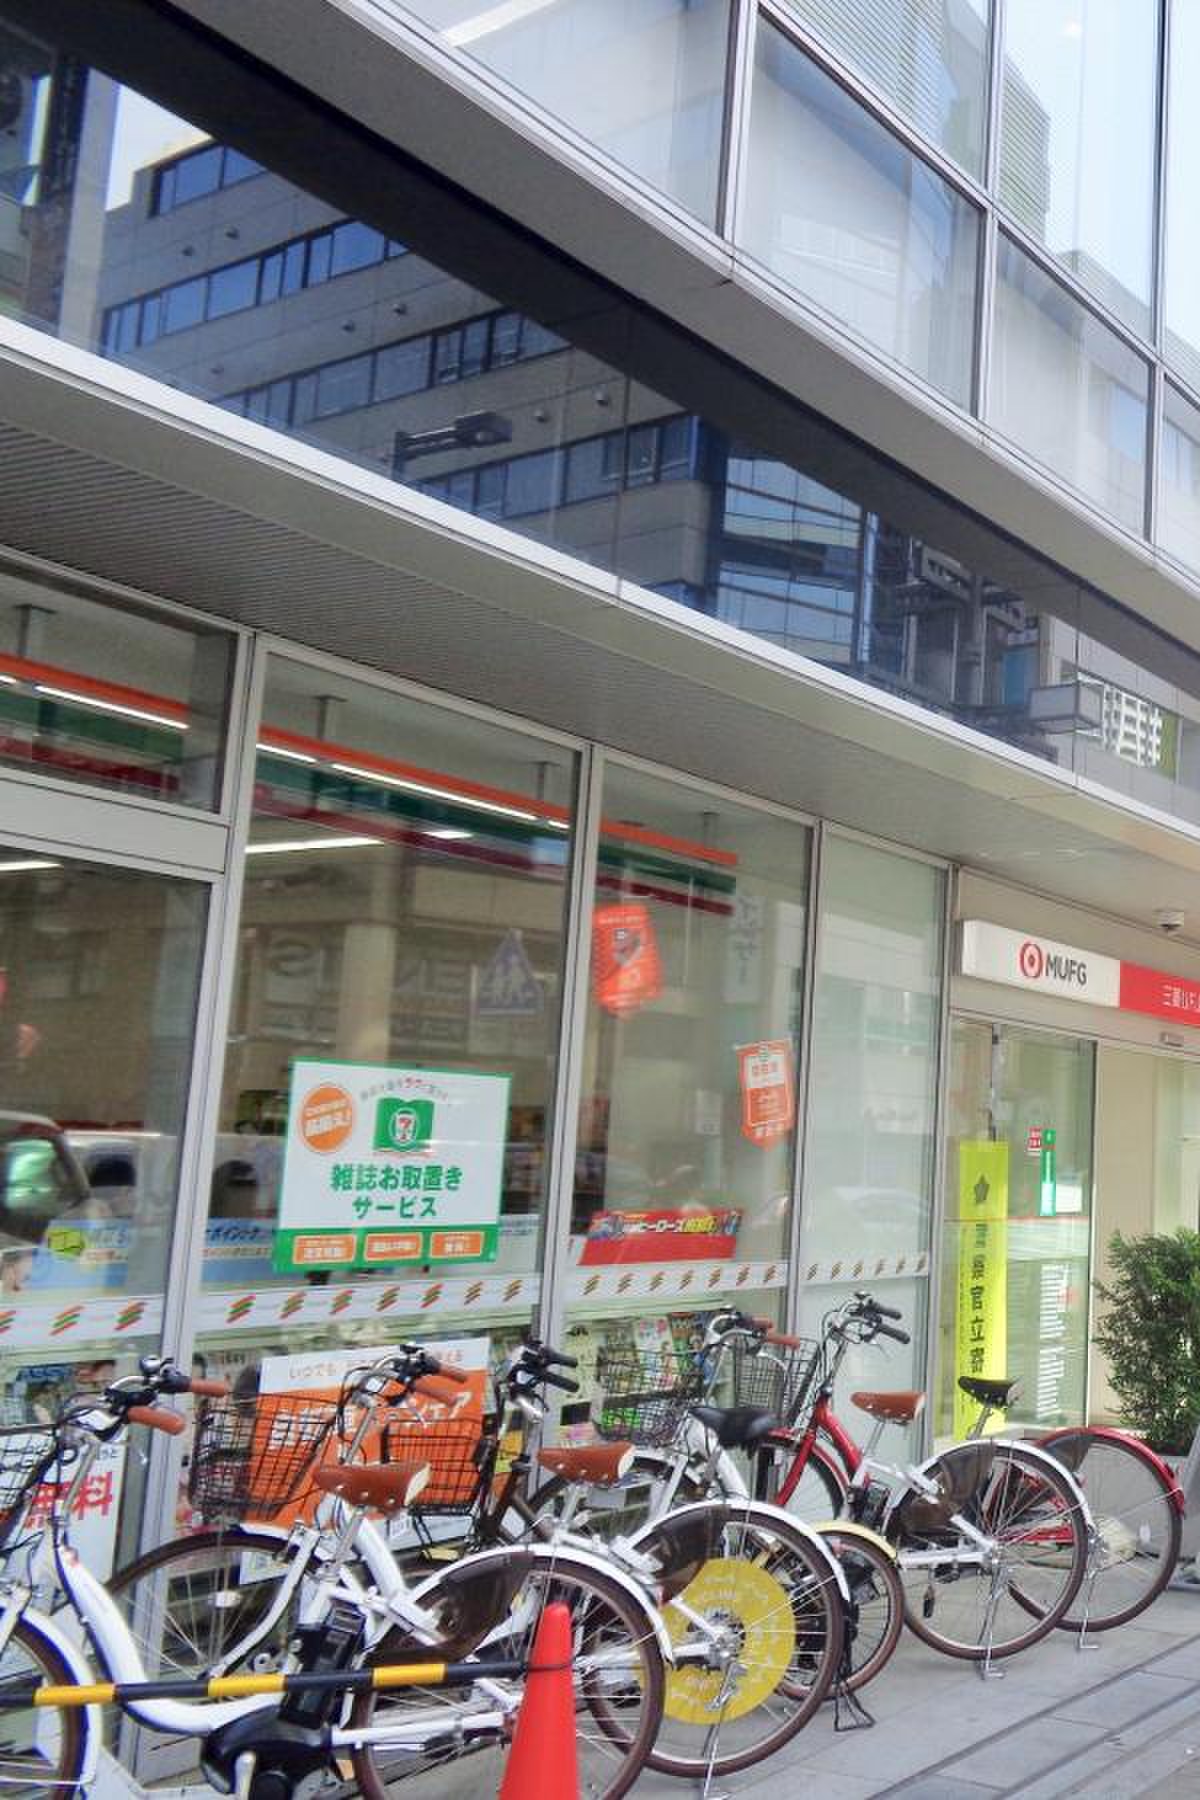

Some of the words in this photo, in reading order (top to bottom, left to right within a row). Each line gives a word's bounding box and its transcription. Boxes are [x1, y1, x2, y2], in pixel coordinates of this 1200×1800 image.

[1045, 953, 1088, 986] MUFG
[330, 1163, 463, 1192] 雑誌お取置き
[352, 1196, 437, 1219] サービス
